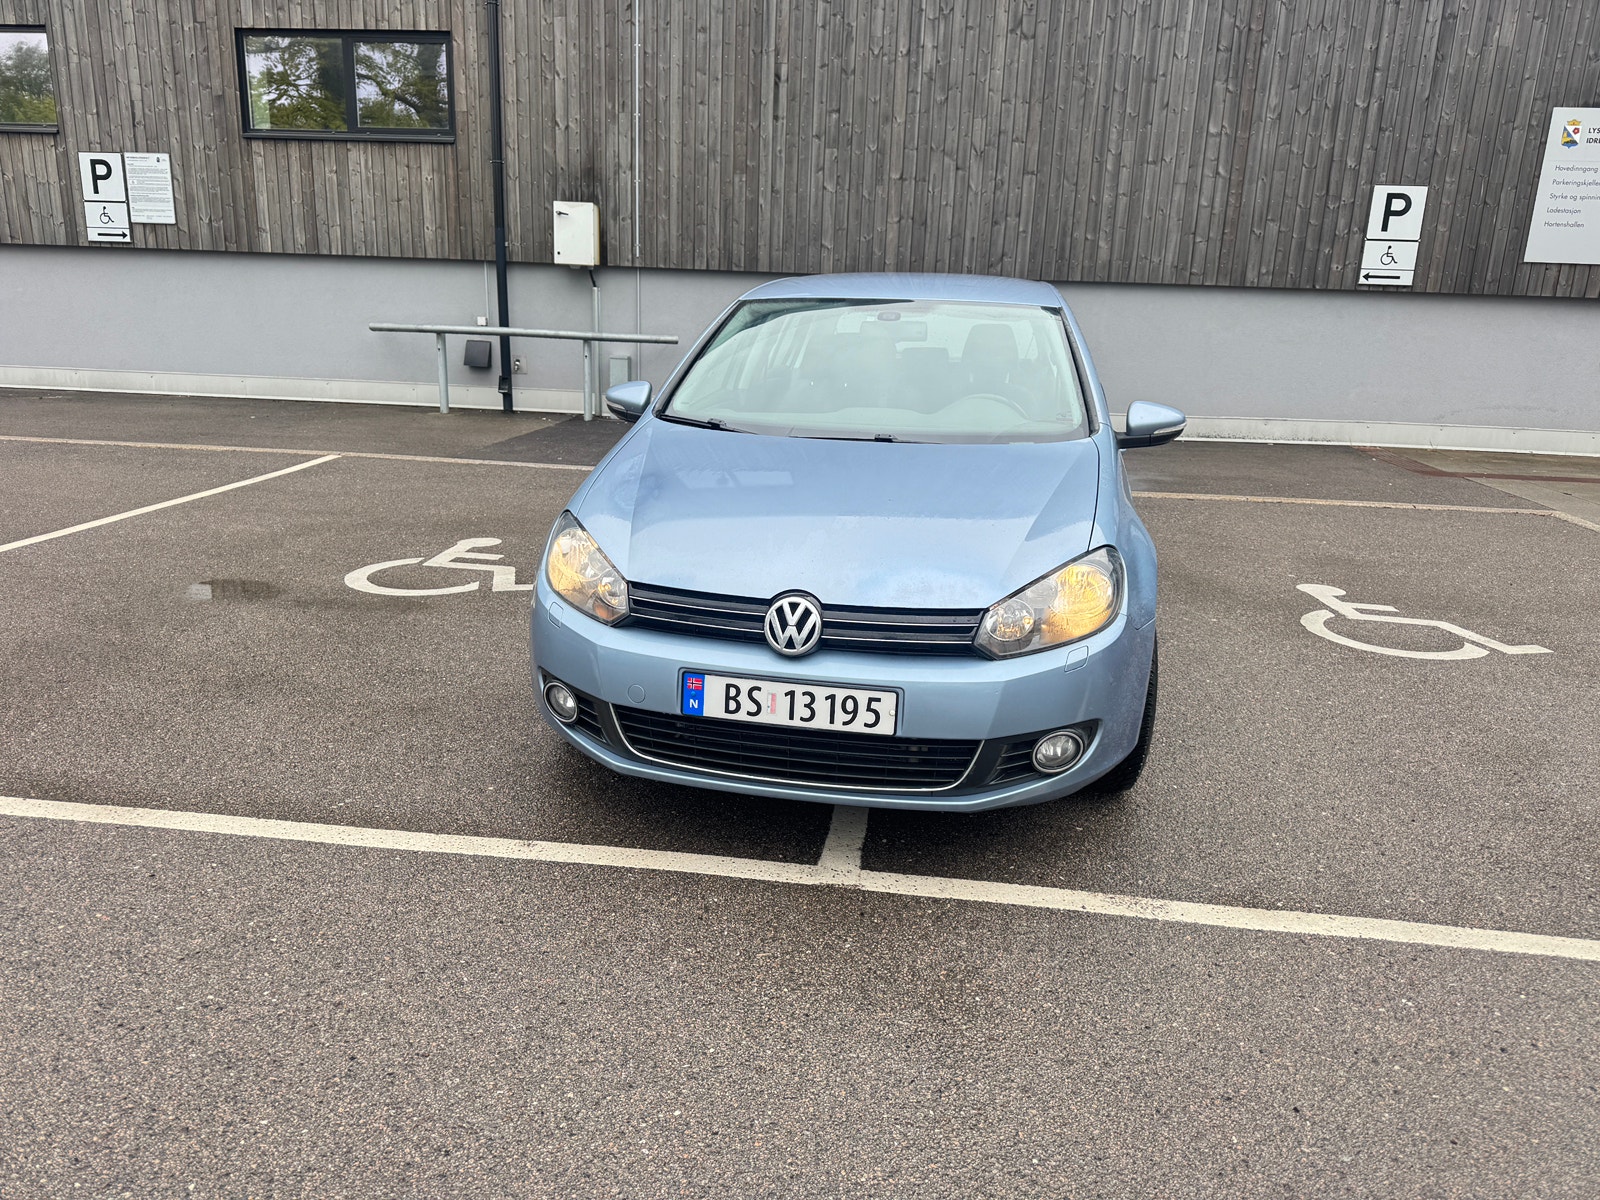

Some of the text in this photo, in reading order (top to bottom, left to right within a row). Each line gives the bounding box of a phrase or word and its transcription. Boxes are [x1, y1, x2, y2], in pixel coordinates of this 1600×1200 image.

[1555, 165, 1599, 173] Hovedinngang
[89, 158, 112, 195] P
[1549, 192, 1568, 201] Styrke
[1381, 192, 1412, 232] P
[1546, 206, 1581, 215] Ladestasjon
[1543, 220, 1585, 228] Hortenshallen
[766, 598, 820, 651] VW
[689, 699, 698, 709] N
[724, 683, 882, 728] BS 13195
